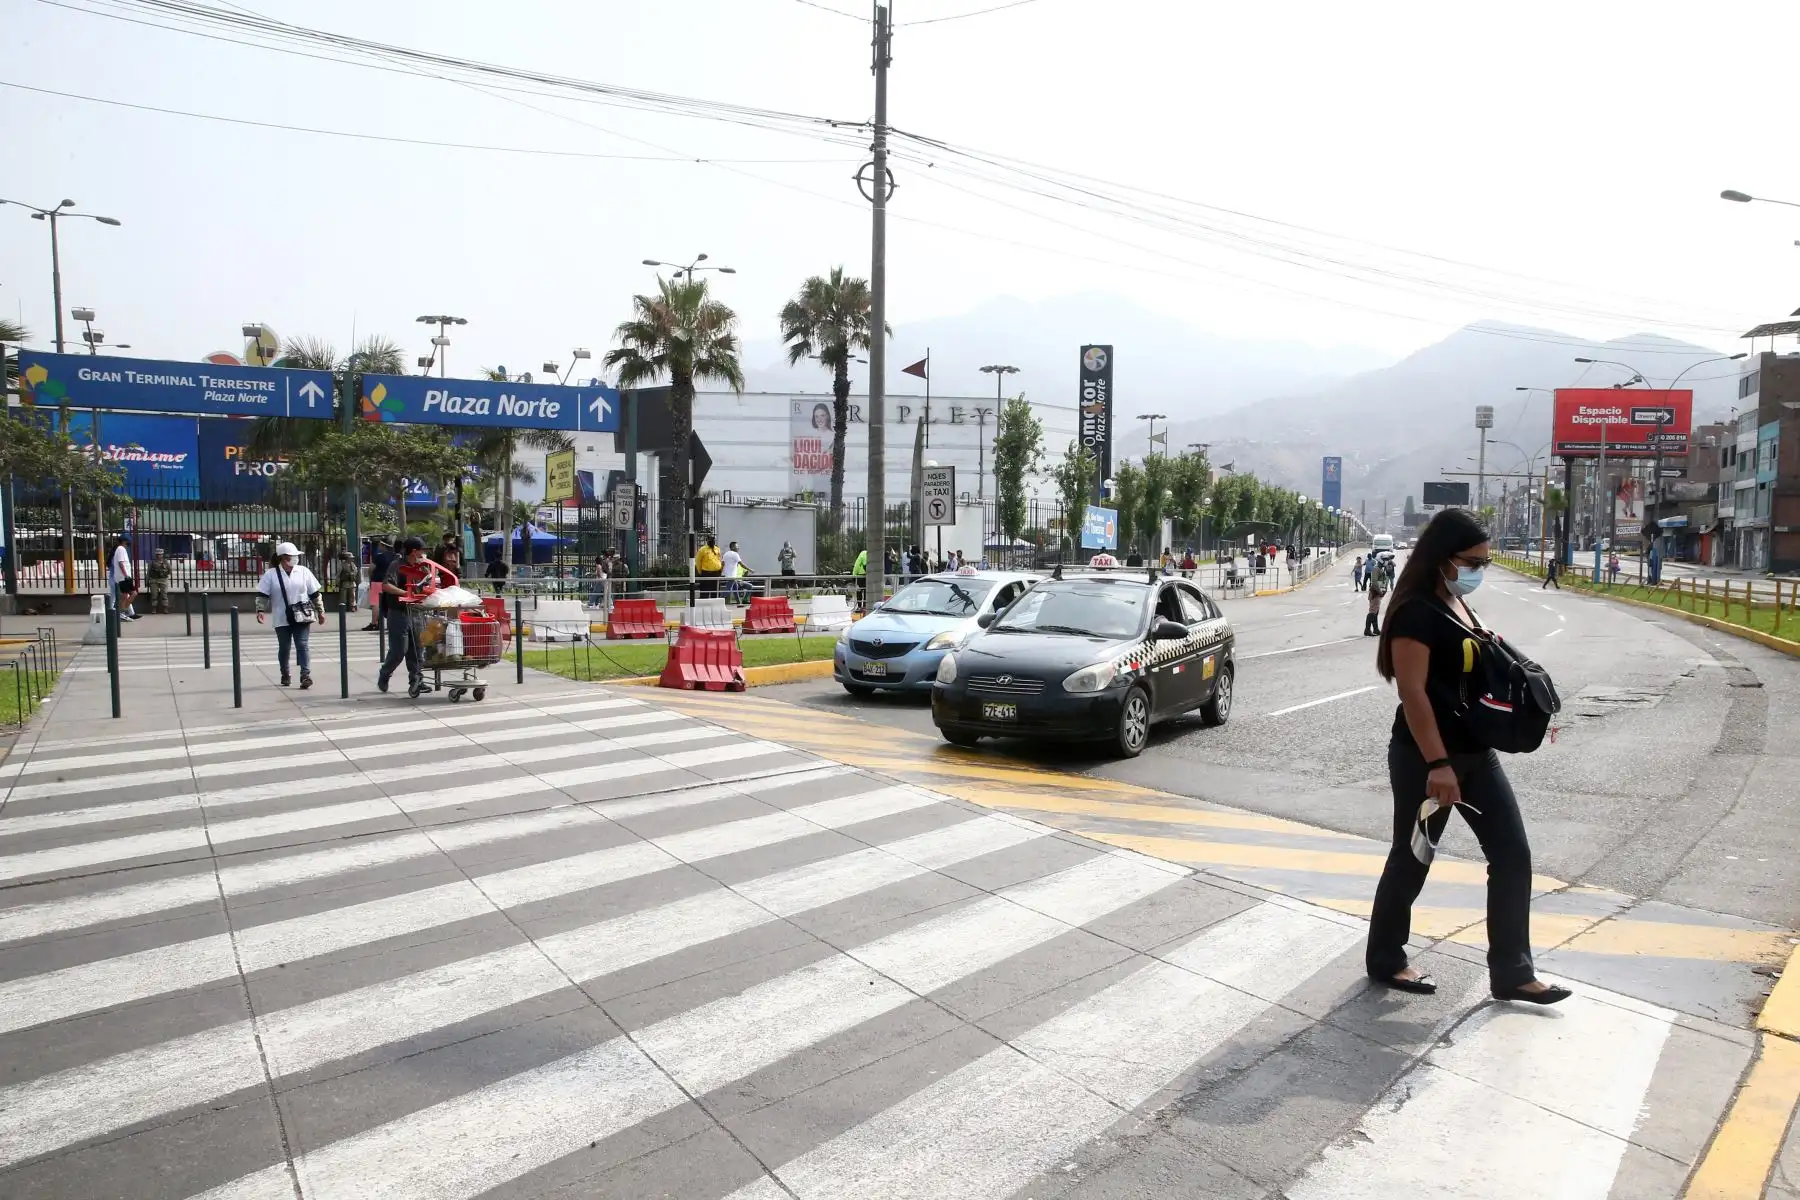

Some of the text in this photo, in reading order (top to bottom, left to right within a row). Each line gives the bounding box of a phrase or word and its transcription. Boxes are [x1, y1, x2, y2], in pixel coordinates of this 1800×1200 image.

[78, 368, 276, 392] GRAN TERMINAL TERRESTRE
[204, 390, 268, 404] Plaza Norte
[423, 390, 561, 418] Plaza Norte
[847, 404, 990, 425] RPLEY
[1579, 406, 1622, 415] Espacio
[1572, 415, 1628, 425] Disponible
[794, 439, 822, 453] LIQUI
[933, 487, 950, 496] TAXI
[1093, 558, 1112, 566] TAXI
